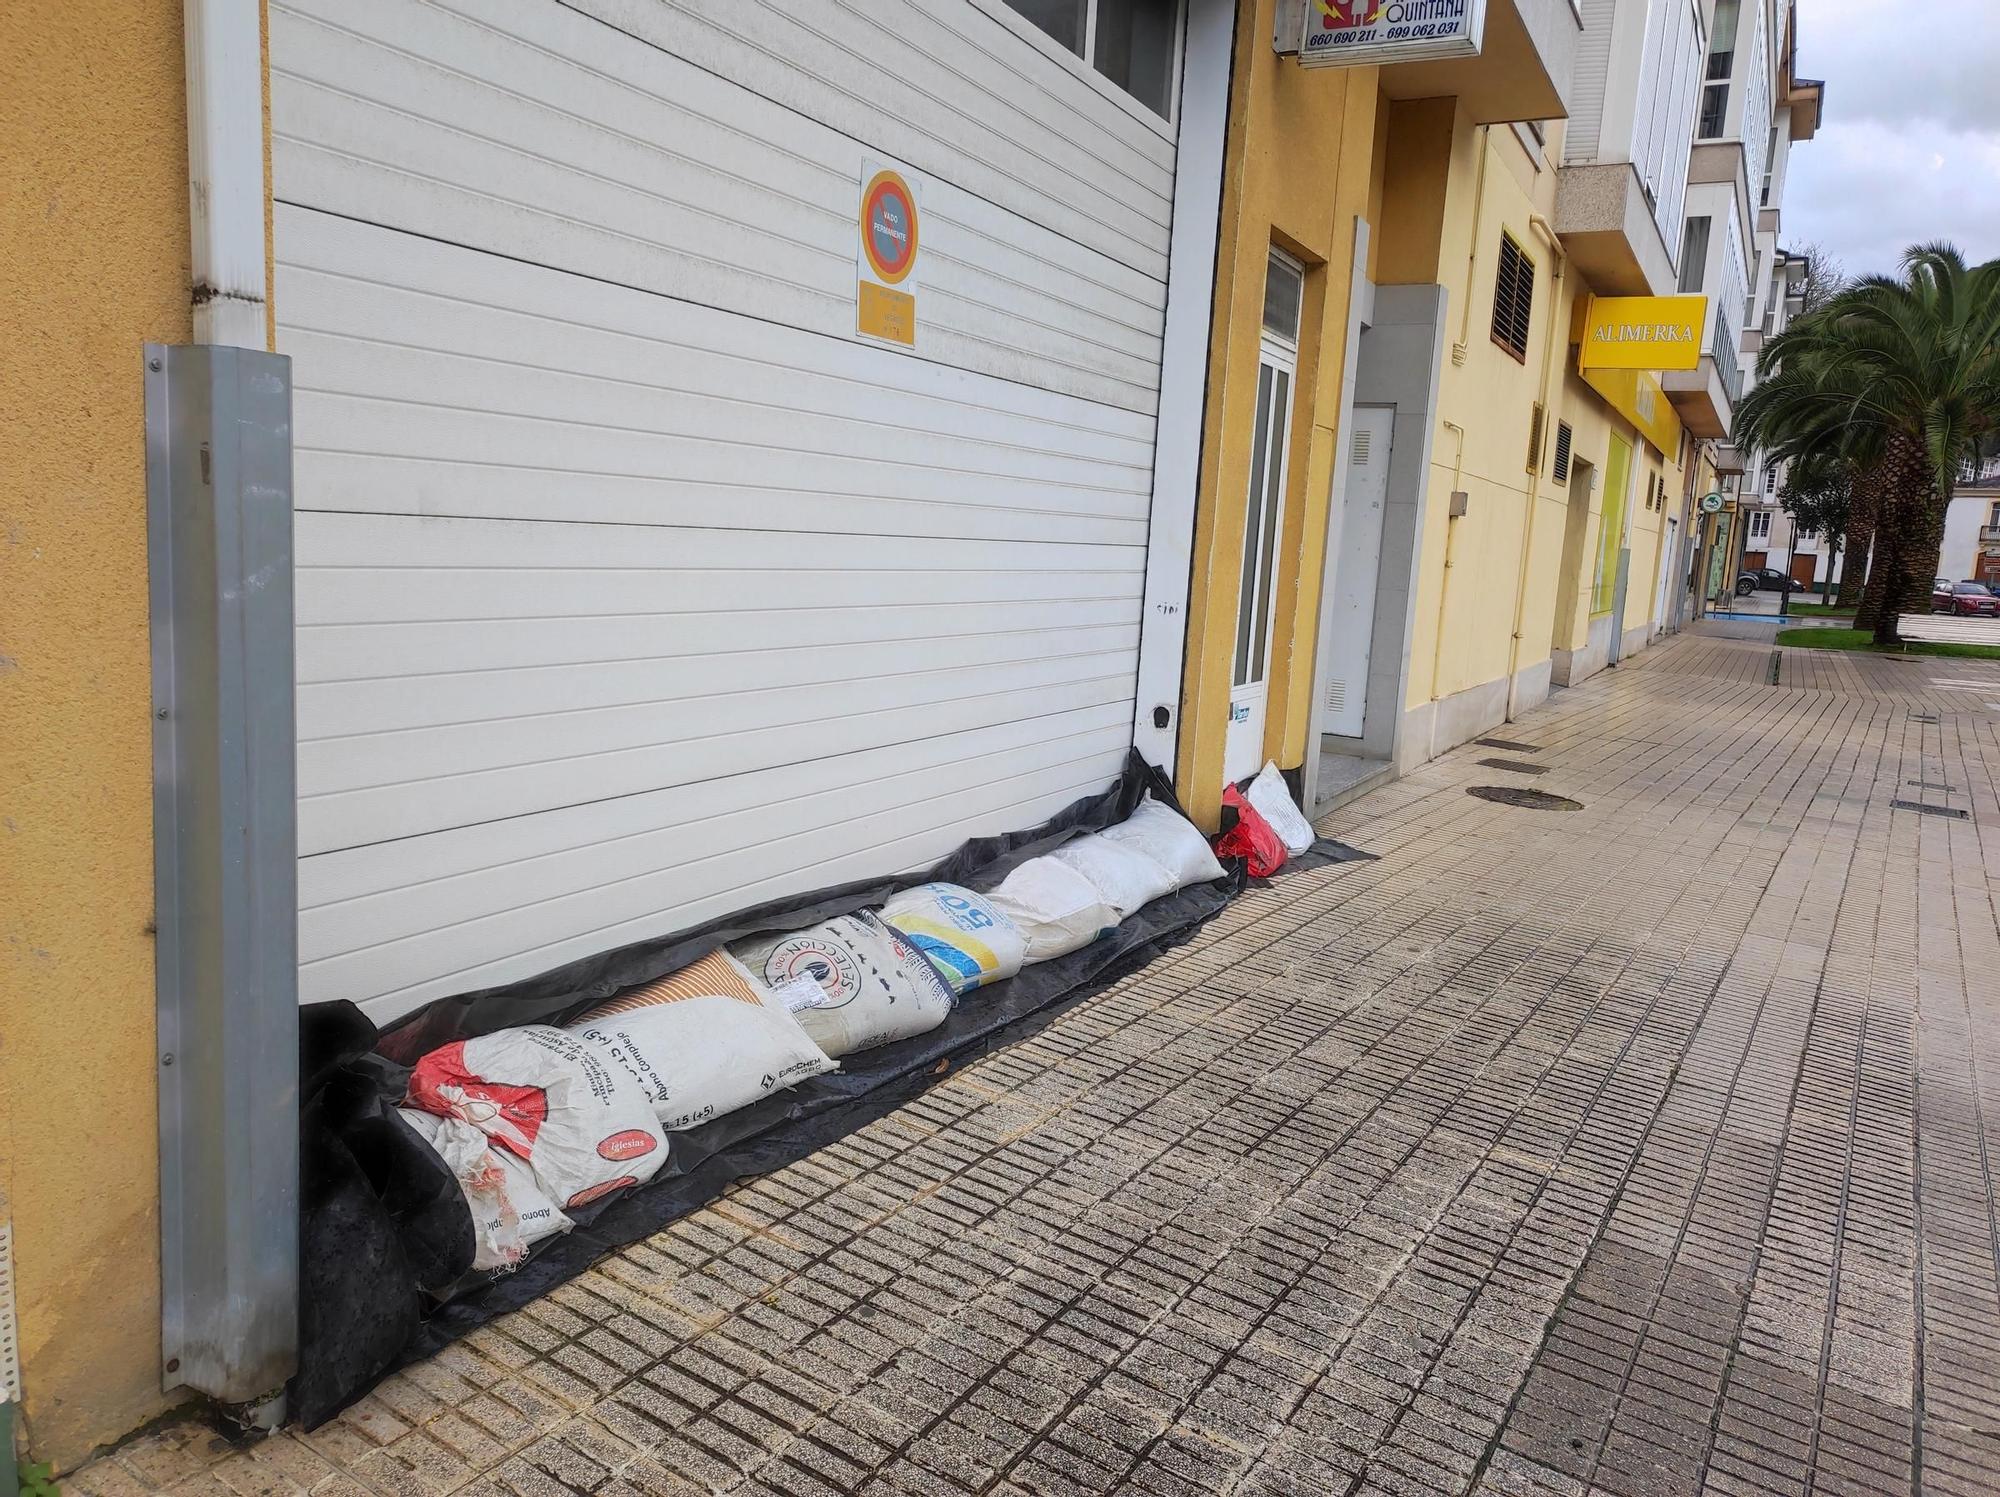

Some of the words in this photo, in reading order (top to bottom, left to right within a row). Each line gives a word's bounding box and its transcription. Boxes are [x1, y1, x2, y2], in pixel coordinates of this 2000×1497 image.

[1386, 0, 1464, 23] QUINTANA
[1309, 33, 1333, 46] 660
[1333, 31, 1355, 44] 690
[1357, 29, 1377, 43] 211
[1386, 26, 1410, 39] 699
[1411, 23, 1435, 37] 062
[1436, 21, 1460, 34] 031
[883, 211, 899, 224] VADO
[874, 222, 906, 242] PERMANENTE
[1593, 324, 1694, 342] ALIMERKA
[787, 939, 856, 991] SELECCIÓN
[615, 1031, 651, 1072] Complejo
[648, 1071, 670, 1101] Abono
[692, 1104, 713, 1121] (+5)
[610, 1138, 645, 1153] Iglesias
[521, 1207, 551, 1222] Abono
